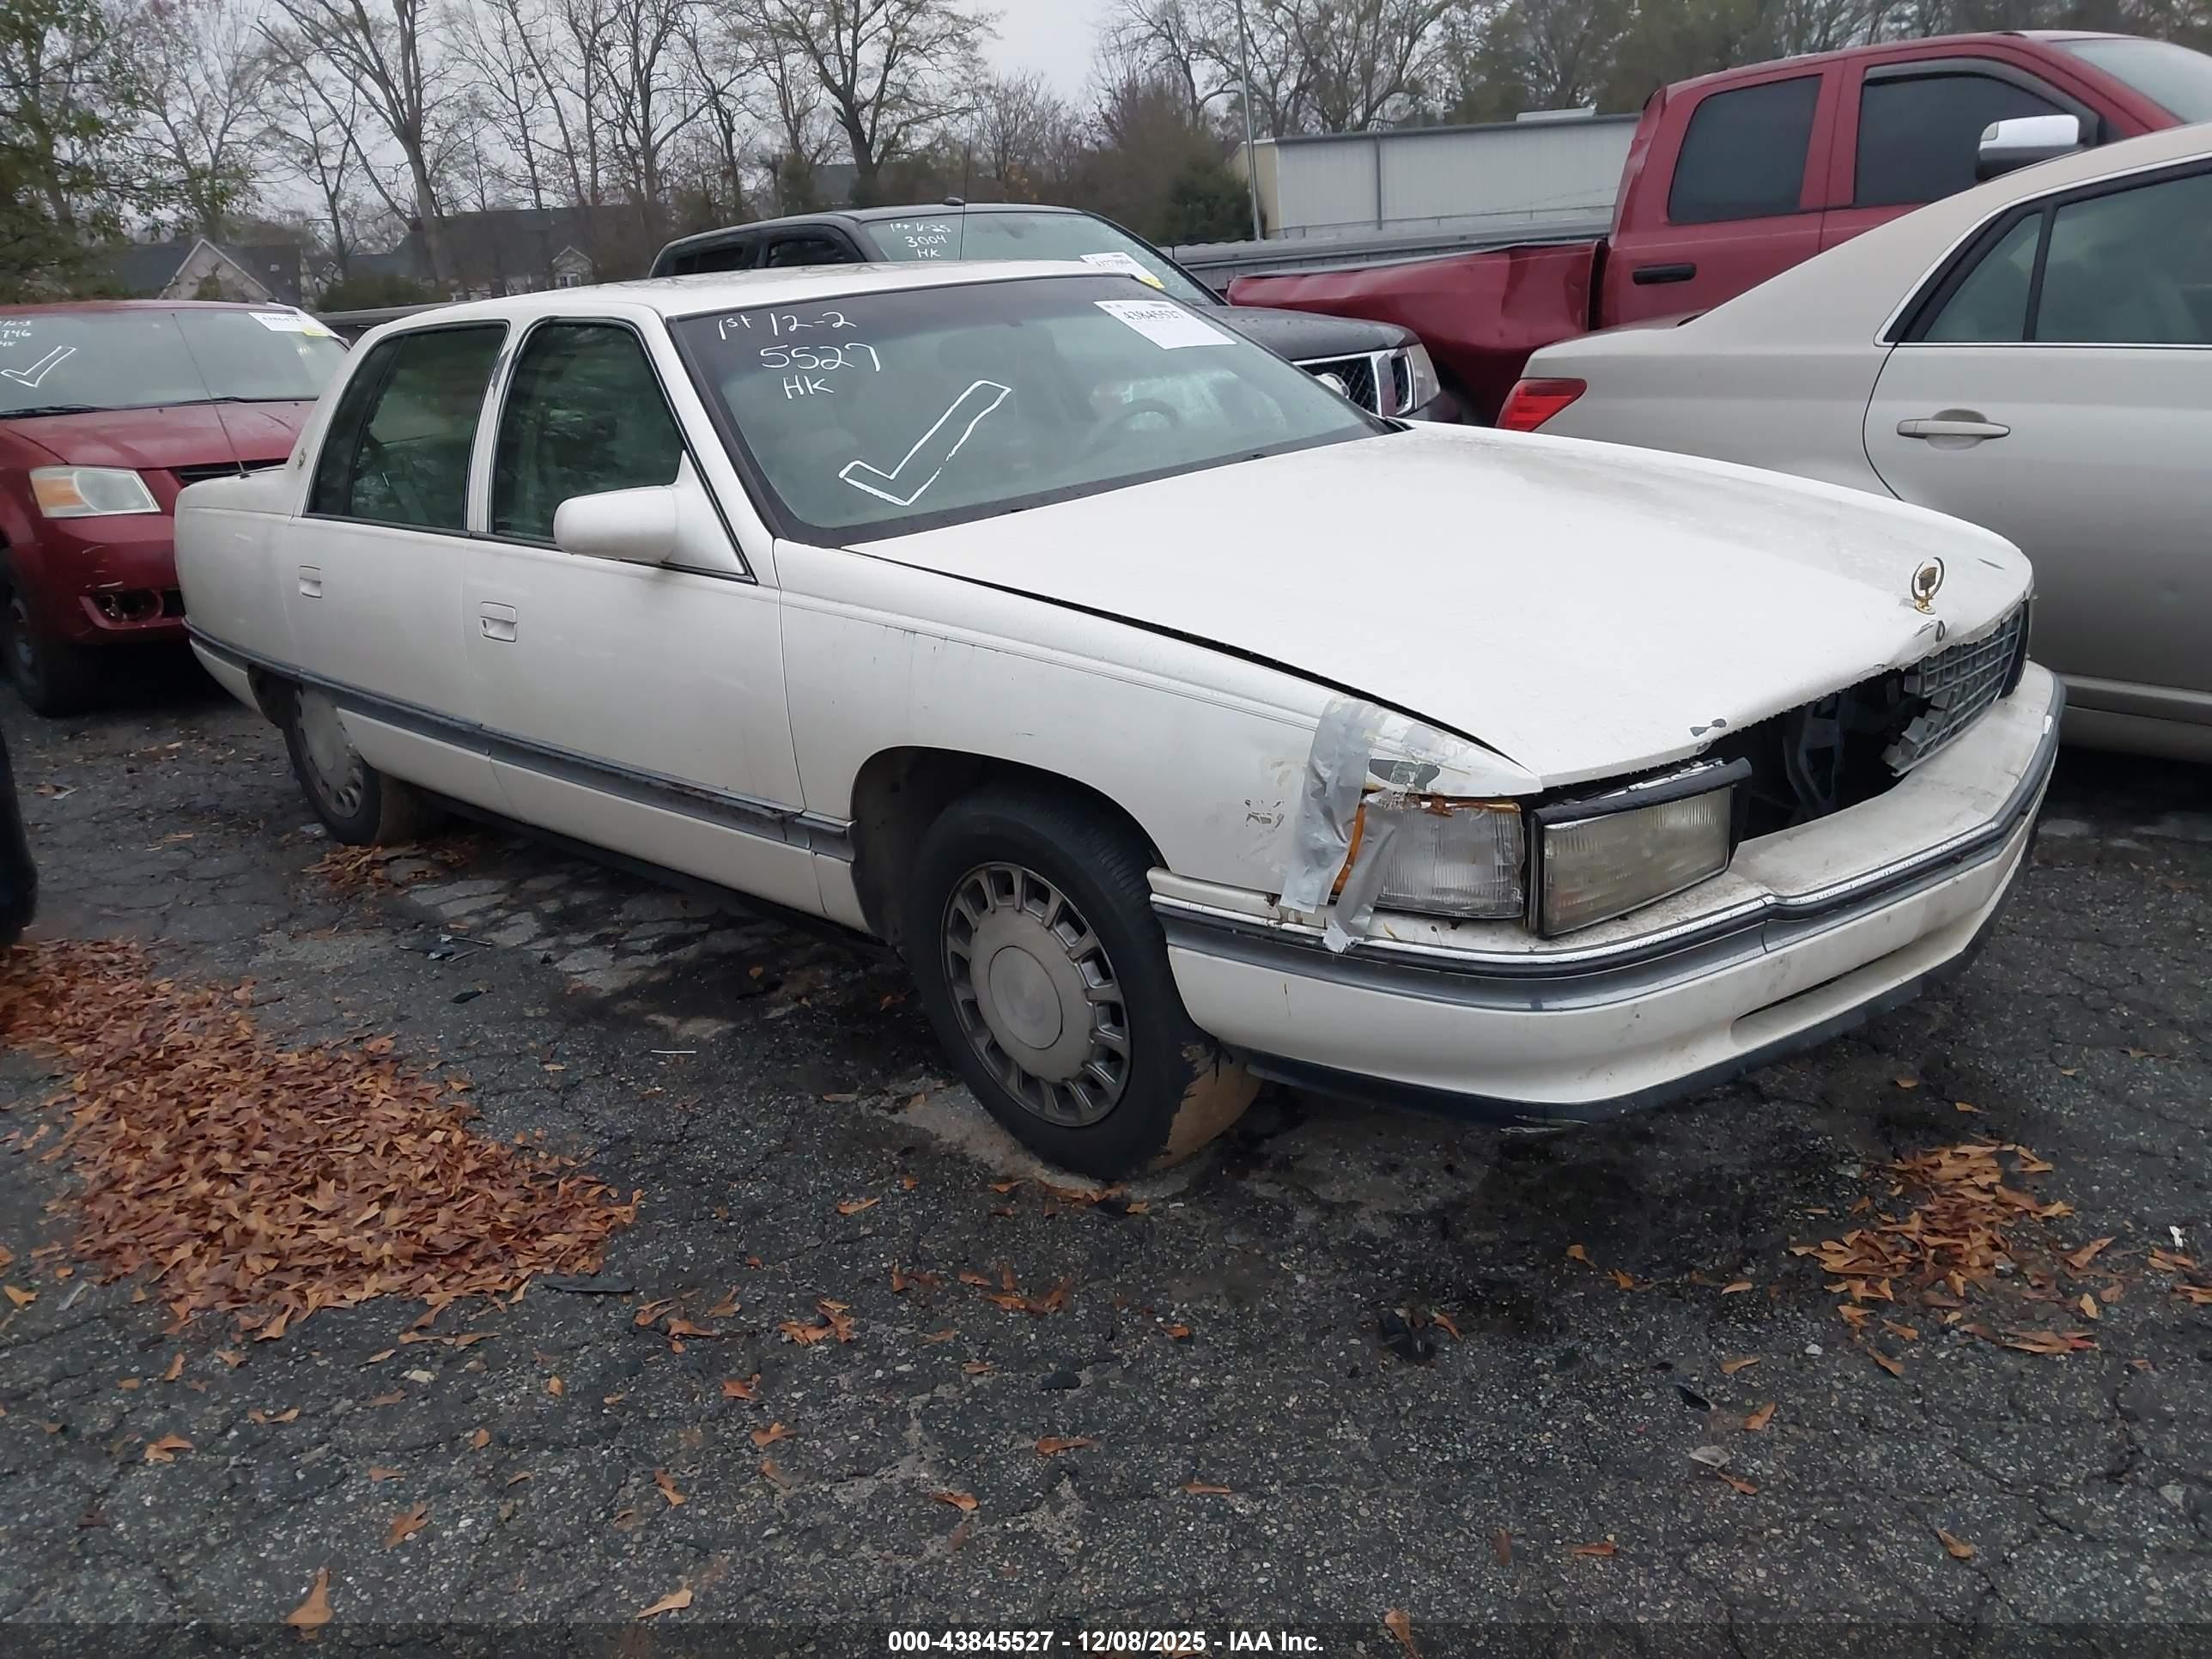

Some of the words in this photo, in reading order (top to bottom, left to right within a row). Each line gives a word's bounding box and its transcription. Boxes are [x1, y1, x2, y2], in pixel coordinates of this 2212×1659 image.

[904, 234, 947, 247] 3004
[917, 248, 941, 258] HK
[718, 314, 752, 340] 1st
[770, 311, 858, 337] 12-2
[759, 343, 881, 372] 5527
[783, 374, 835, 399] HK
